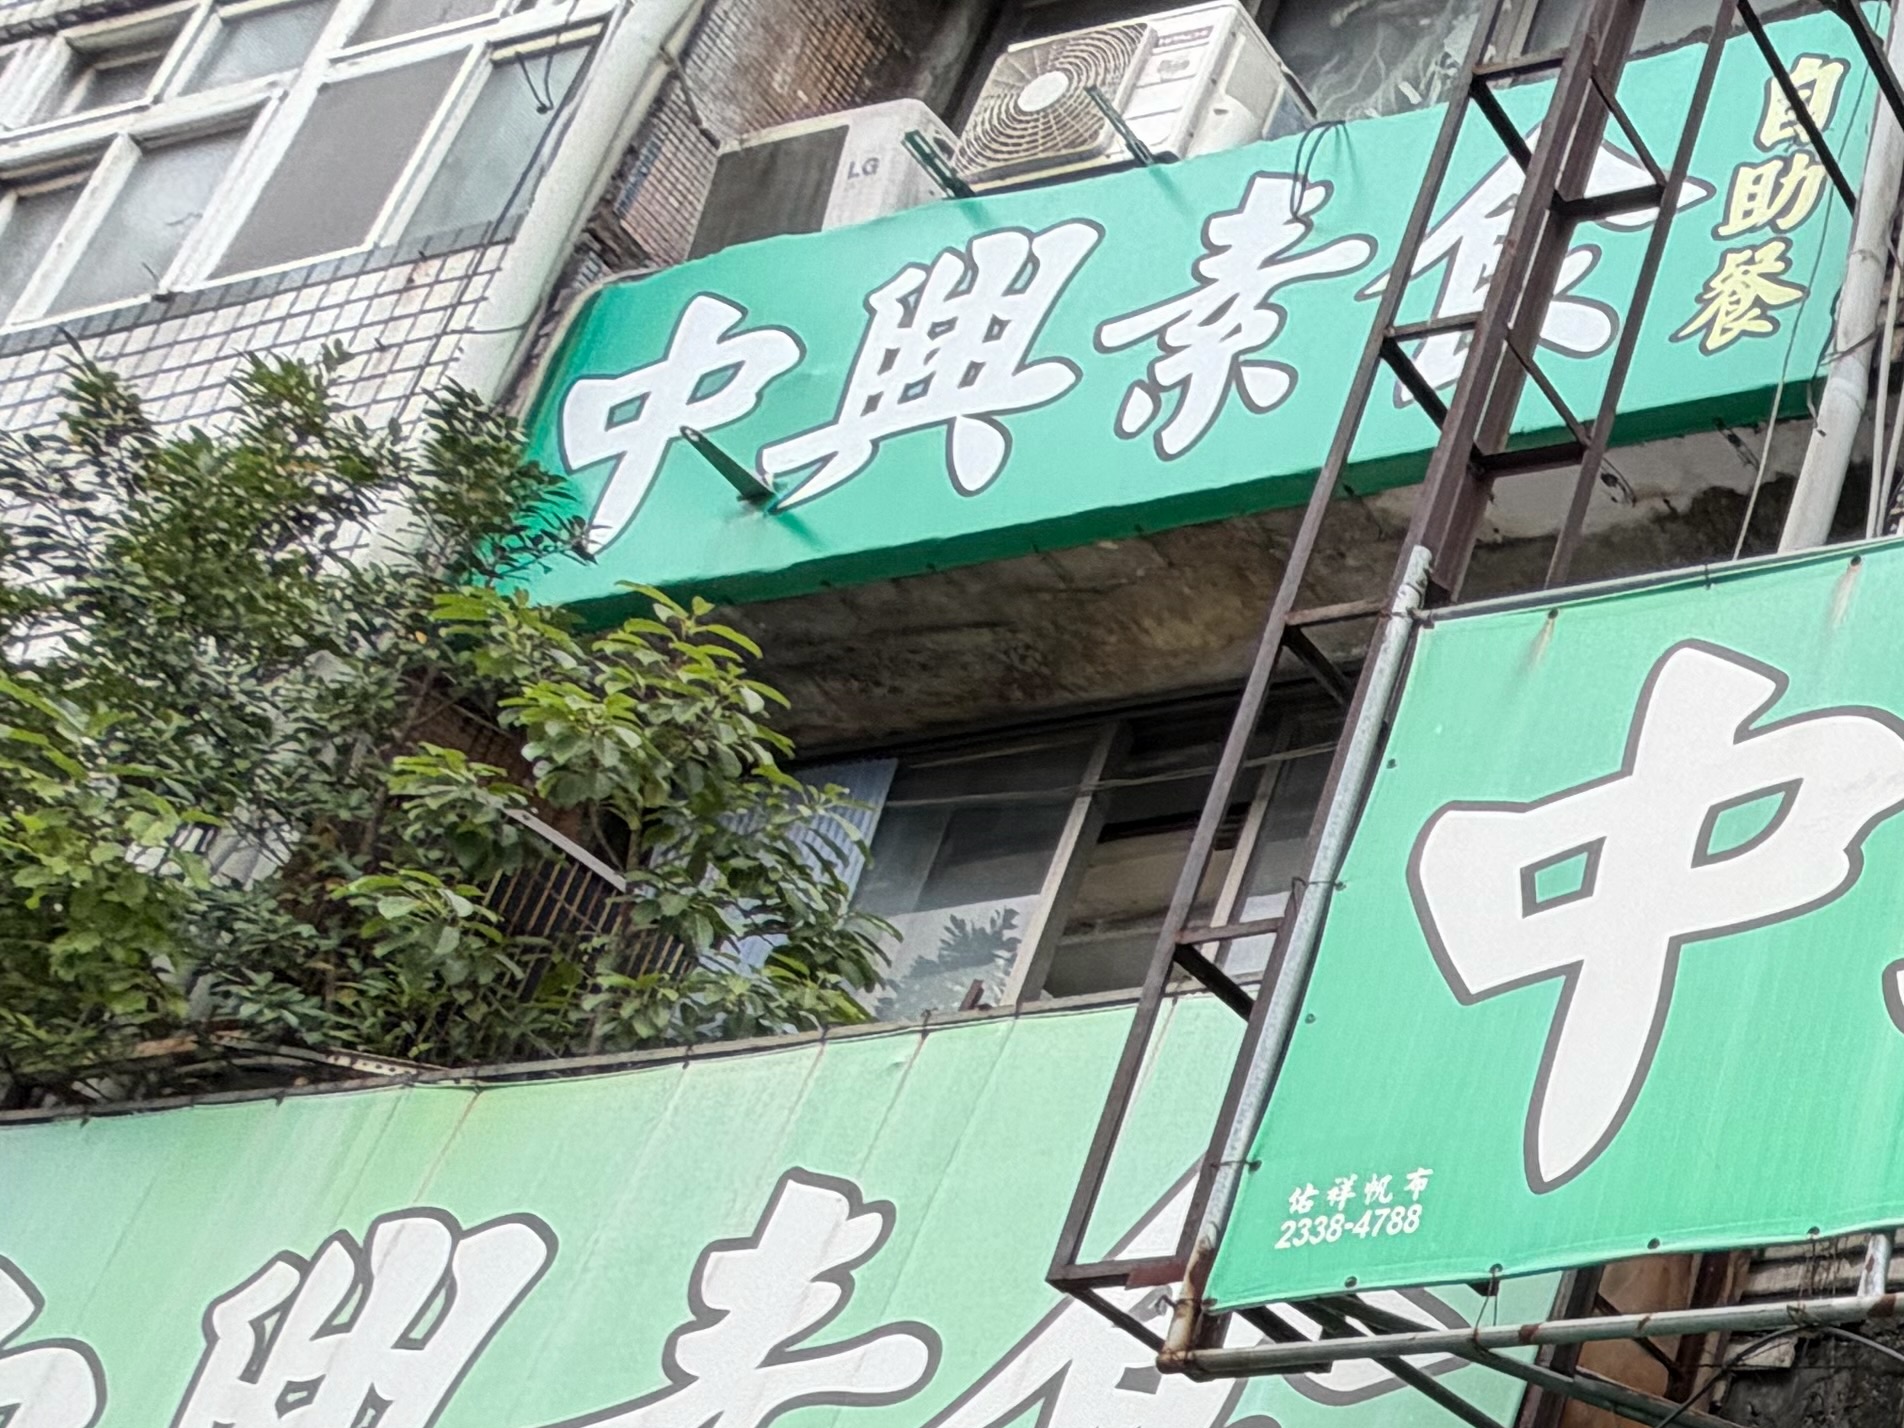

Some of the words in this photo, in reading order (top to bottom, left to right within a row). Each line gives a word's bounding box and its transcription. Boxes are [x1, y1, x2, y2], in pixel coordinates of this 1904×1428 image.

[847, 160, 880, 181] LG
[1674, 53, 1848, 354] 自助餐
[559, 118, 1713, 556] 中興素食
[1274, 1204, 1423, 1249] 2338-4788
